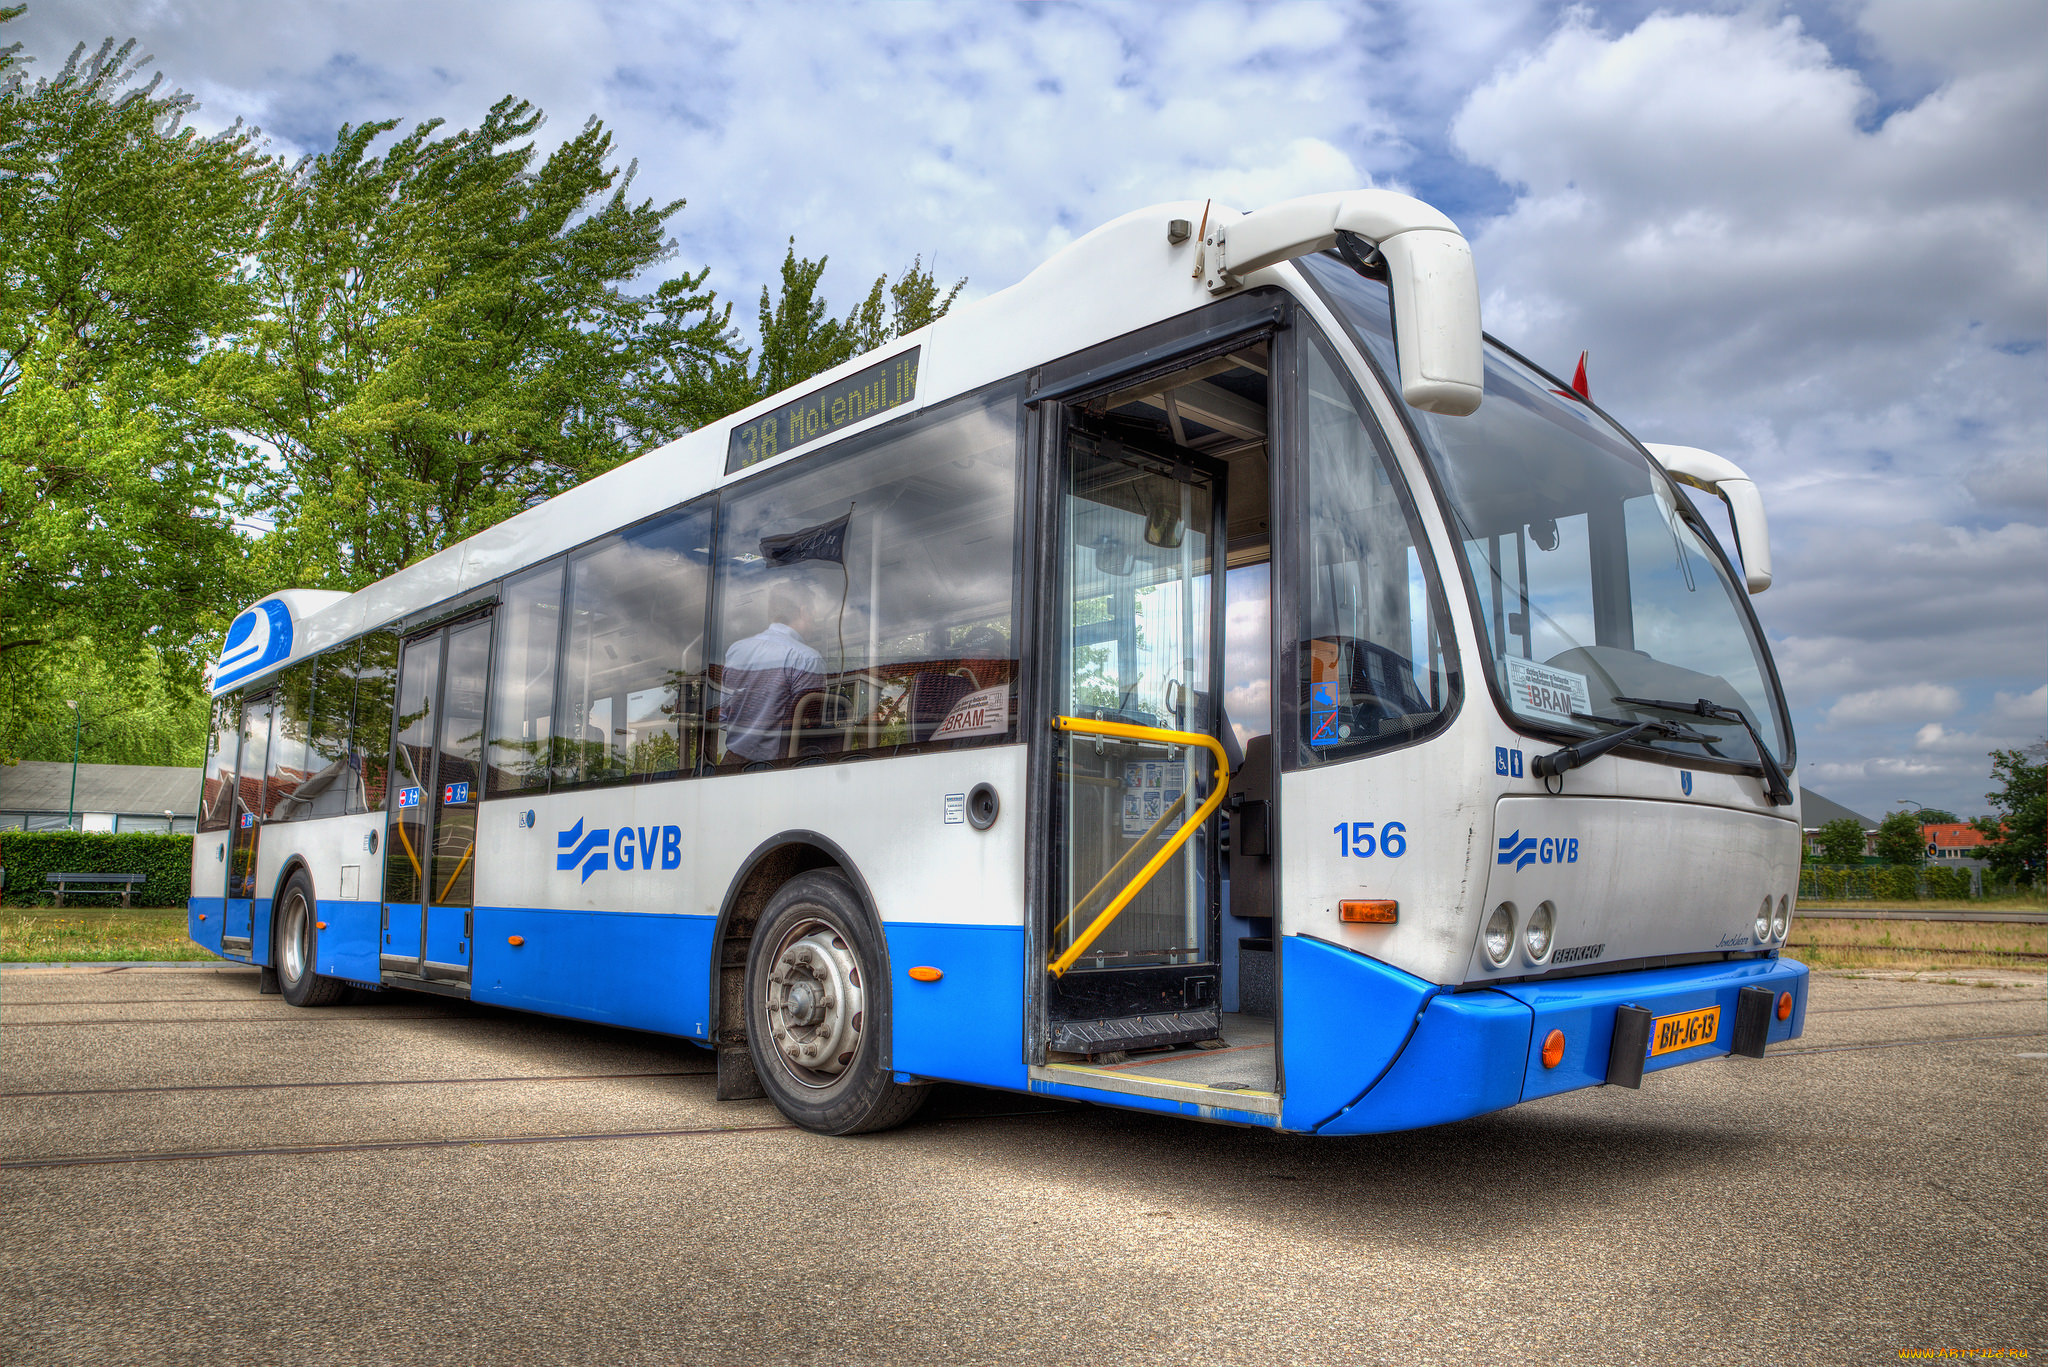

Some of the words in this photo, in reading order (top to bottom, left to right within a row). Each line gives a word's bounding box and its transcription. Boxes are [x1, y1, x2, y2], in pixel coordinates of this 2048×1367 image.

[742, 416, 777, 468] 38
[790, 359, 918, 444] Molenwijk
[1532, 685, 1572, 714] BRAM
[945, 708, 985, 731] BRAM
[614, 825, 682, 871] GVB
[1333, 821, 1407, 858] 156
[1539, 837, 1579, 864] GVB
[1551, 943, 1606, 964] BERKHOF
[1660, 1013, 1714, 1049] BH-JG-13
